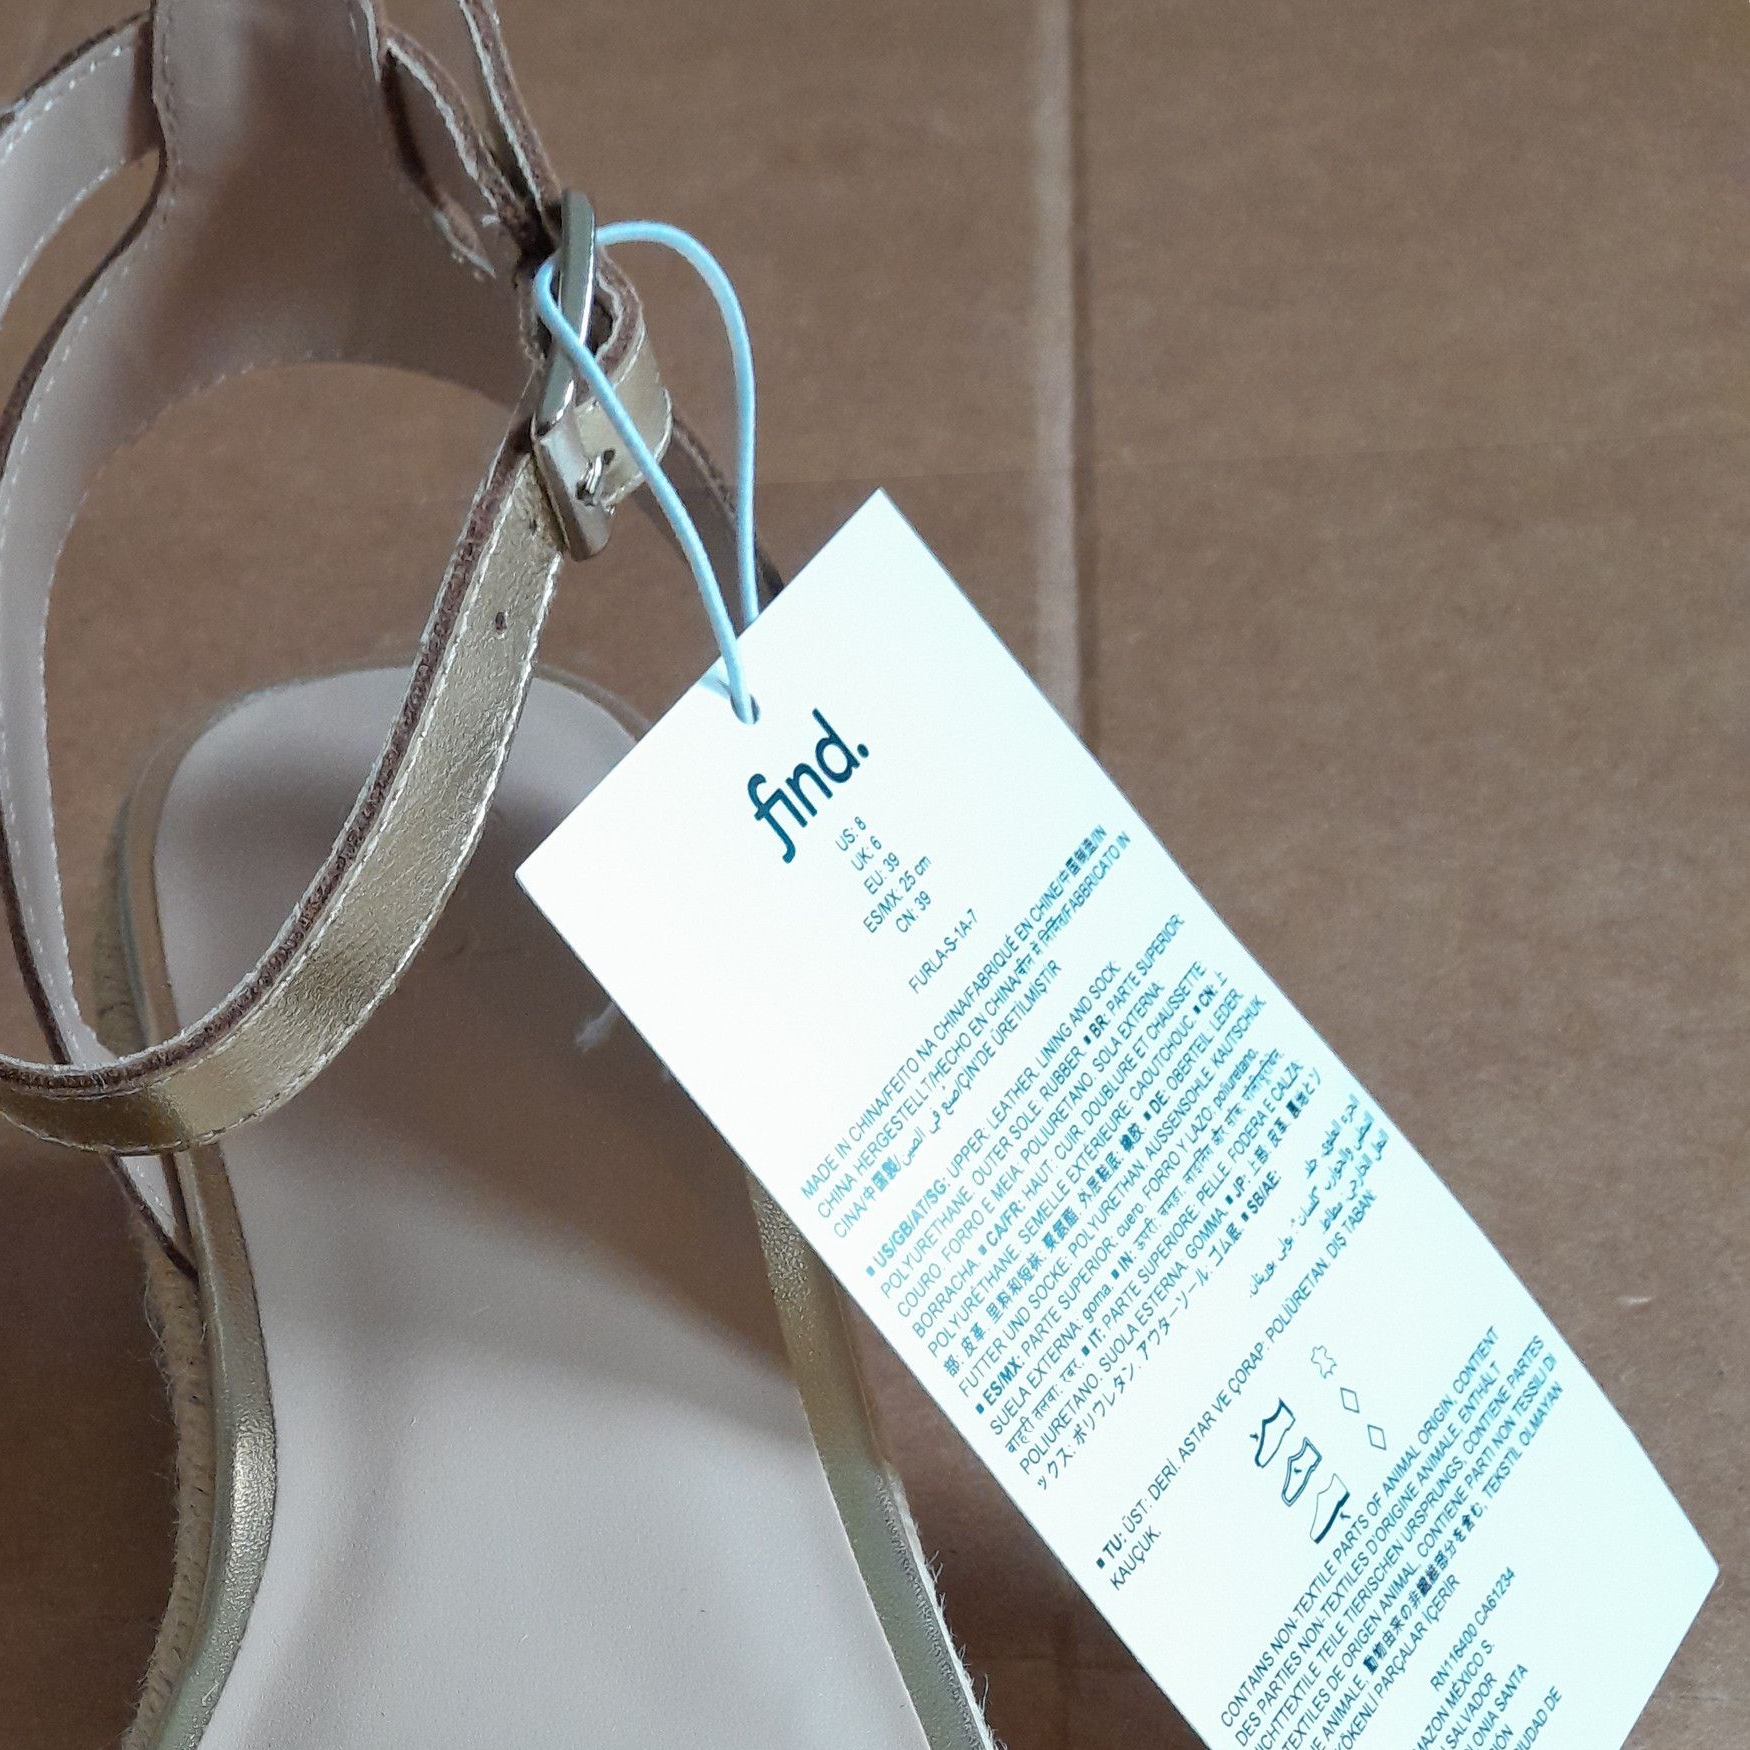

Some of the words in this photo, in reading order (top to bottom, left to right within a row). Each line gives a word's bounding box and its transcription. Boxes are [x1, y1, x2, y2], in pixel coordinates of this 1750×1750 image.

[747, 707, 869, 864] find.
[835, 827, 858, 851] US:
[854, 816, 866, 832] 8
[851, 847, 874, 871] UK:
[870, 835, 882, 850] 6
[863, 870, 887, 896] EU:
[883, 852, 900, 873] 39
[863, 888, 904, 933] ES/MX:
[899, 870, 916, 893] 25
[914, 856, 931, 876] cm
[895, 908, 919, 933] CN:
[914, 891, 931, 911] 39
[909, 908, 977, 994] FURLA-S-1A-7
[801, 1154, 839, 1200] MADE
[835, 1138, 852, 1159] IN
[849, 1057, 919, 1141] CHINA/FEITO
[916, 1038, 938, 1062] NA
[933, 934, 1019, 1040] CHINA/FABRIQUÉ
[1014, 918, 1034, 942] EN
[818, 1173, 857, 1218] CHINA
[853, 1032, 971, 1176] HERGESTELLT/HECHO
[968, 1013, 989, 1038] EN
[873, 1177, 950, 1268] US/GB/AT/SG:
[986, 1067, 1040, 1130] LEATHER.
[1035, 1022, 1072, 1069] LINING
[1069, 996, 1093, 1028] AND
[881, 1186, 975, 1299] POLYURETHANE.
[972, 1136, 1014, 1186] OUTER
[1106, 971, 1141, 1016] PARTE
[941, 1210, 984, 1263] FORRO
[981, 1197, 995, 1214] E
[1020, 1072, 1096, 1165] POLIURETANO.
[1092, 1036, 1122, 1073] SOLA
[986, 1200, 1026, 1247] CA/FR:
[1081, 1053, 1138, 1126] DOUBLURE
[1132, 1035, 1149, 1059] ET
[1247, 1170, 1281, 1215] SB/AE:
[982, 1356, 1025, 1406] ES/MX:
[1021, 1306, 1062, 1357] PARTE
[1058, 1236, 1118, 1310] SUPERIOR:
[1142, 1151, 1180, 1201] FORRO
[1176, 1138, 1188, 1153] Y
[1018, 1179, 1070, 1245] SEMELLE
[1088, 1327, 1106, 1349] IT:
[1102, 1280, 1142, 1330] PARTE
[1227, 1110, 1268, 1163] FODERA
[1263, 1098, 1276, 1114] E
[959, 1338, 1008, 1398] FUTTER
[1002, 1307, 1030, 1341] UND
[1028, 1256, 1072, 1310] SOCKE:
[990, 1386, 1032, 1435] SUELA
[1026, 1319, 1084, 1389] EXTERNA:
[1082, 1284, 1114, 1324] goma.
[1117, 1251, 1136, 1272] IN:
[1102, 1533, 1127, 1559] TU:
[1178, 1411, 1217, 1463] ASTAR
[1211, 1389, 1232, 1413] VE
[1228, 1341, 1269, 1395] ÇORAP:
[1326, 1232, 1347, 1259] DIŞ
[1019, 1373, 1103, 1475] POLIURETANO.
[1099, 1323, 1139, 1373] SUOLA
[1110, 1525, 1161, 1591] KAUÇUK.
[1221, 1651, 1274, 1727] CONTAINS
[1270, 1559, 1338, 1655] NON-TEXTILE
[1333, 1514, 1369, 1564] PARTS
[1366, 1491, 1382, 1516] OF
[1382, 1445, 1421, 1498] ANIMAL
[1418, 1394, 1458, 1445] ORIGIN,
[1453, 1326, 1498, 1394] CONTIENT
[1316, 1620, 1348, 1663] TEILE
[1343, 1539, 1405, 1623] TIERISCHEN
[1401, 1456, 1467, 1543] URSPRUNGS,
[1463, 1385, 1511, 1455] CONTIENE
[1506, 1335, 1544, 1389] PARTES
[1326, 1664, 1346, 1692] DE
[1342, 1609, 1382, 1668] ORIGEN
[1417, 1485, 1469, 1558] CONTIENE
[1464, 1445, 1496, 1489] PARTI
[1491, 1414, 1516, 1449] NON
[1235, 1712, 1261, 1747] DES
[1256, 1651, 1302, 1715] PARTIES
[1298, 1552, 1370, 1654] NON-TEXTILES
[1416, 1423, 1464, 1487] ANIMALE,
[1373, 1621, 1428, 1699] PARÇALAR
[1421, 1574, 1460, 1624] İÇERİR
[1430, 1623, 1477, 1692] RN116400
[1474, 1567, 1515, 1626] CA61234
[1322, 1673, 1369, 1742] ANIMALE,
[1445, 1652, 1484, 1710] MÉXICO
[1445, 1672, 1497, 1750] SALVADOR
[1494, 1664, 1528, 1712] SANTA
[1543, 1685, 1562, 1712] DE
